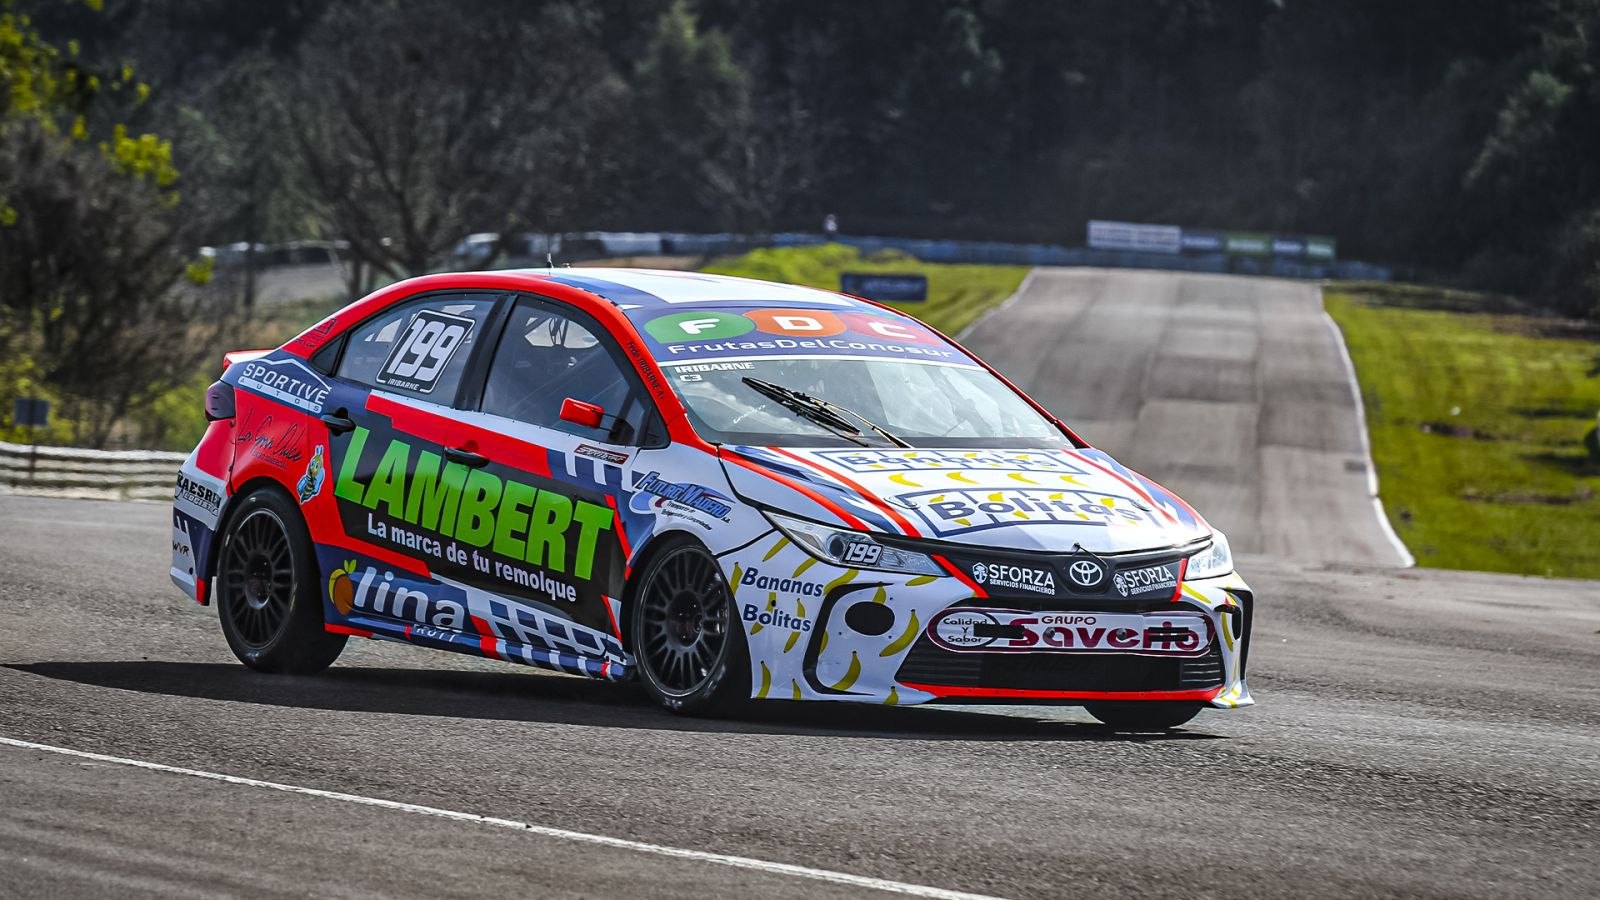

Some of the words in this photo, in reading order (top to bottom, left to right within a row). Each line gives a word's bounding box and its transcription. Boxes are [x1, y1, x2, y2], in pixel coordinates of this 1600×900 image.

[387, 318, 465, 382] 199
[667, 338, 953, 360] FrutasDelConosur
[637, 358, 661, 390] IRIBARNE
[674, 362, 756, 374] IRIBARNE
[679, 374, 703, 382] C3
[240, 377, 321, 413] AUTOS
[242, 363, 330, 405] SPORTIVE
[387, 378, 420, 391] IRIBARNE
[334, 425, 615, 581] LAMBERT
[927, 497, 1144, 522] Bolitas
[367, 513, 387, 538] La
[391, 523, 442, 557] marca
[446, 542, 468, 567] de
[472, 551, 491, 575] tu
[496, 561, 577, 603] remolque
[845, 542, 882, 563] 199
[741, 566, 824, 598] Bananas
[989, 564, 1055, 589] SFORZA
[989, 578, 1019, 589] SERVICIOS
[1019, 582, 1056, 596] FINANCIEROS
[1124, 566, 1175, 588] SFORZA
[353, 566, 464, 630] lina
[1130, 584, 1153, 596] SERVICIOS
[742, 603, 812, 632] Bolitas
[1041, 615, 1097, 625] GRUPO
